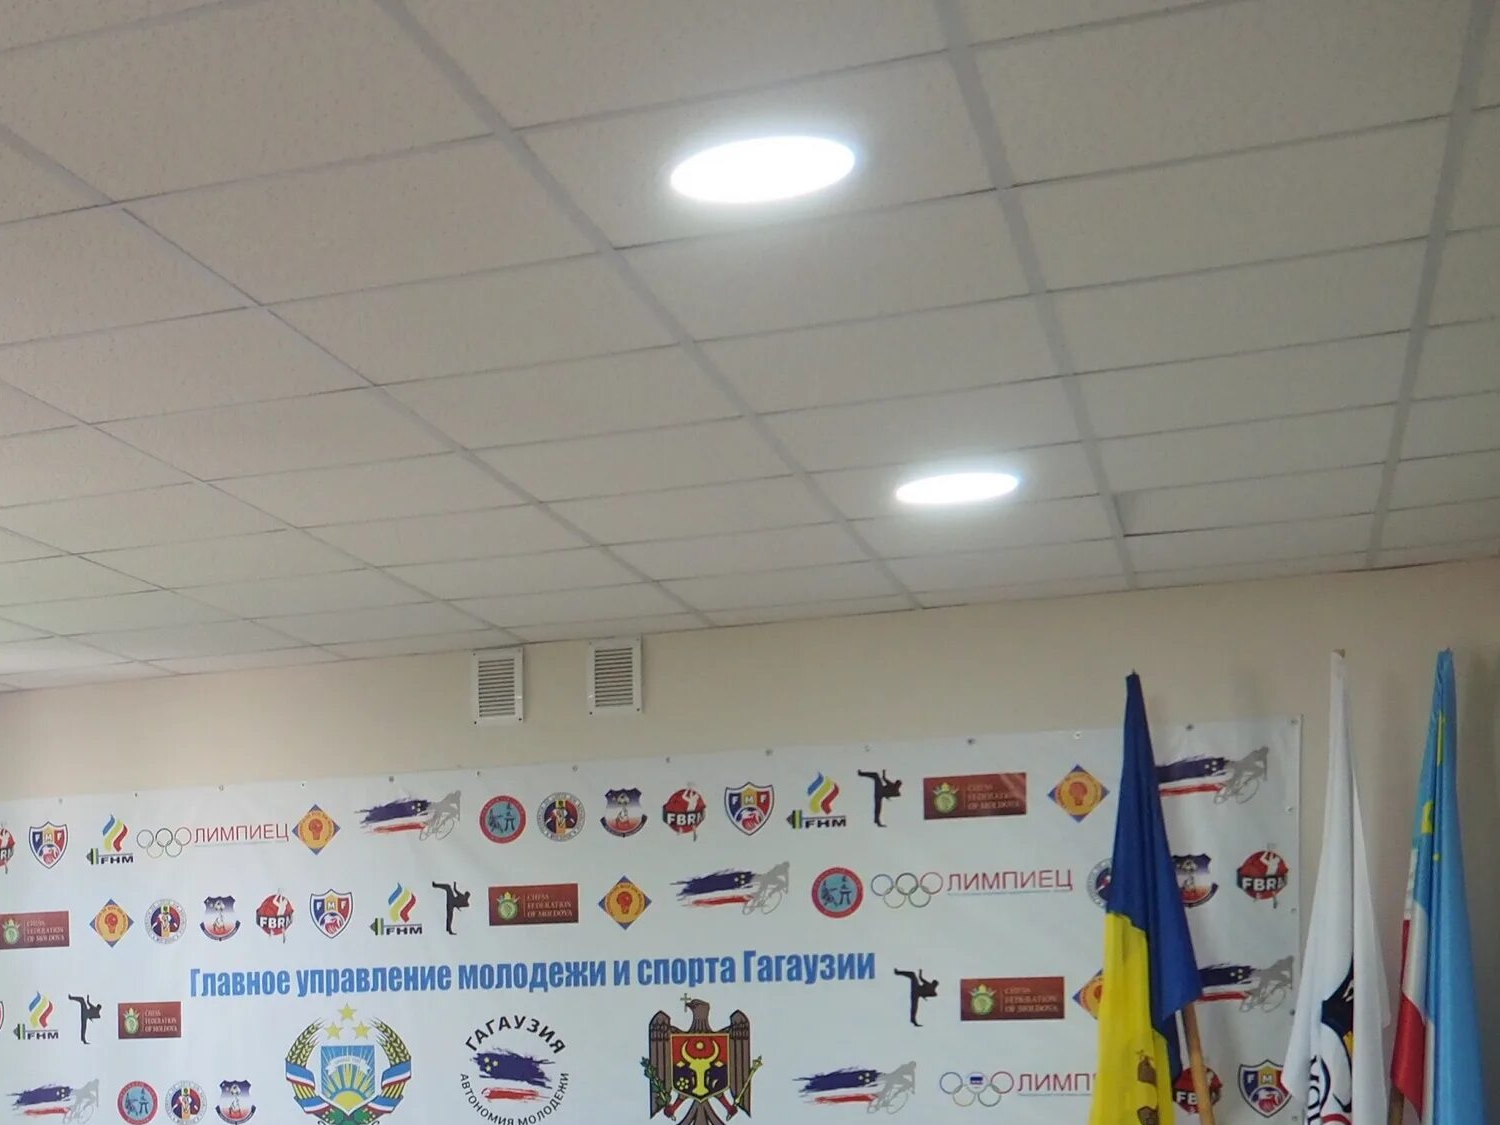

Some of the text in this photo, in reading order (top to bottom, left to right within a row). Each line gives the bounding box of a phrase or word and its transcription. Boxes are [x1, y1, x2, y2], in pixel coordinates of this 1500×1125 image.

[805, 818, 846, 828] FHM
[101, 855, 134, 865] FHM
[386, 926, 422, 935] FHM
[190, 950, 876, 997] Главное управление молодежи и спорта Гагаузии
[27, 1031, 59, 1040] FHM
[465, 1015, 566, 1054] ГАГАУЗИЯ
[1247, 1073, 1273, 1084] FM
